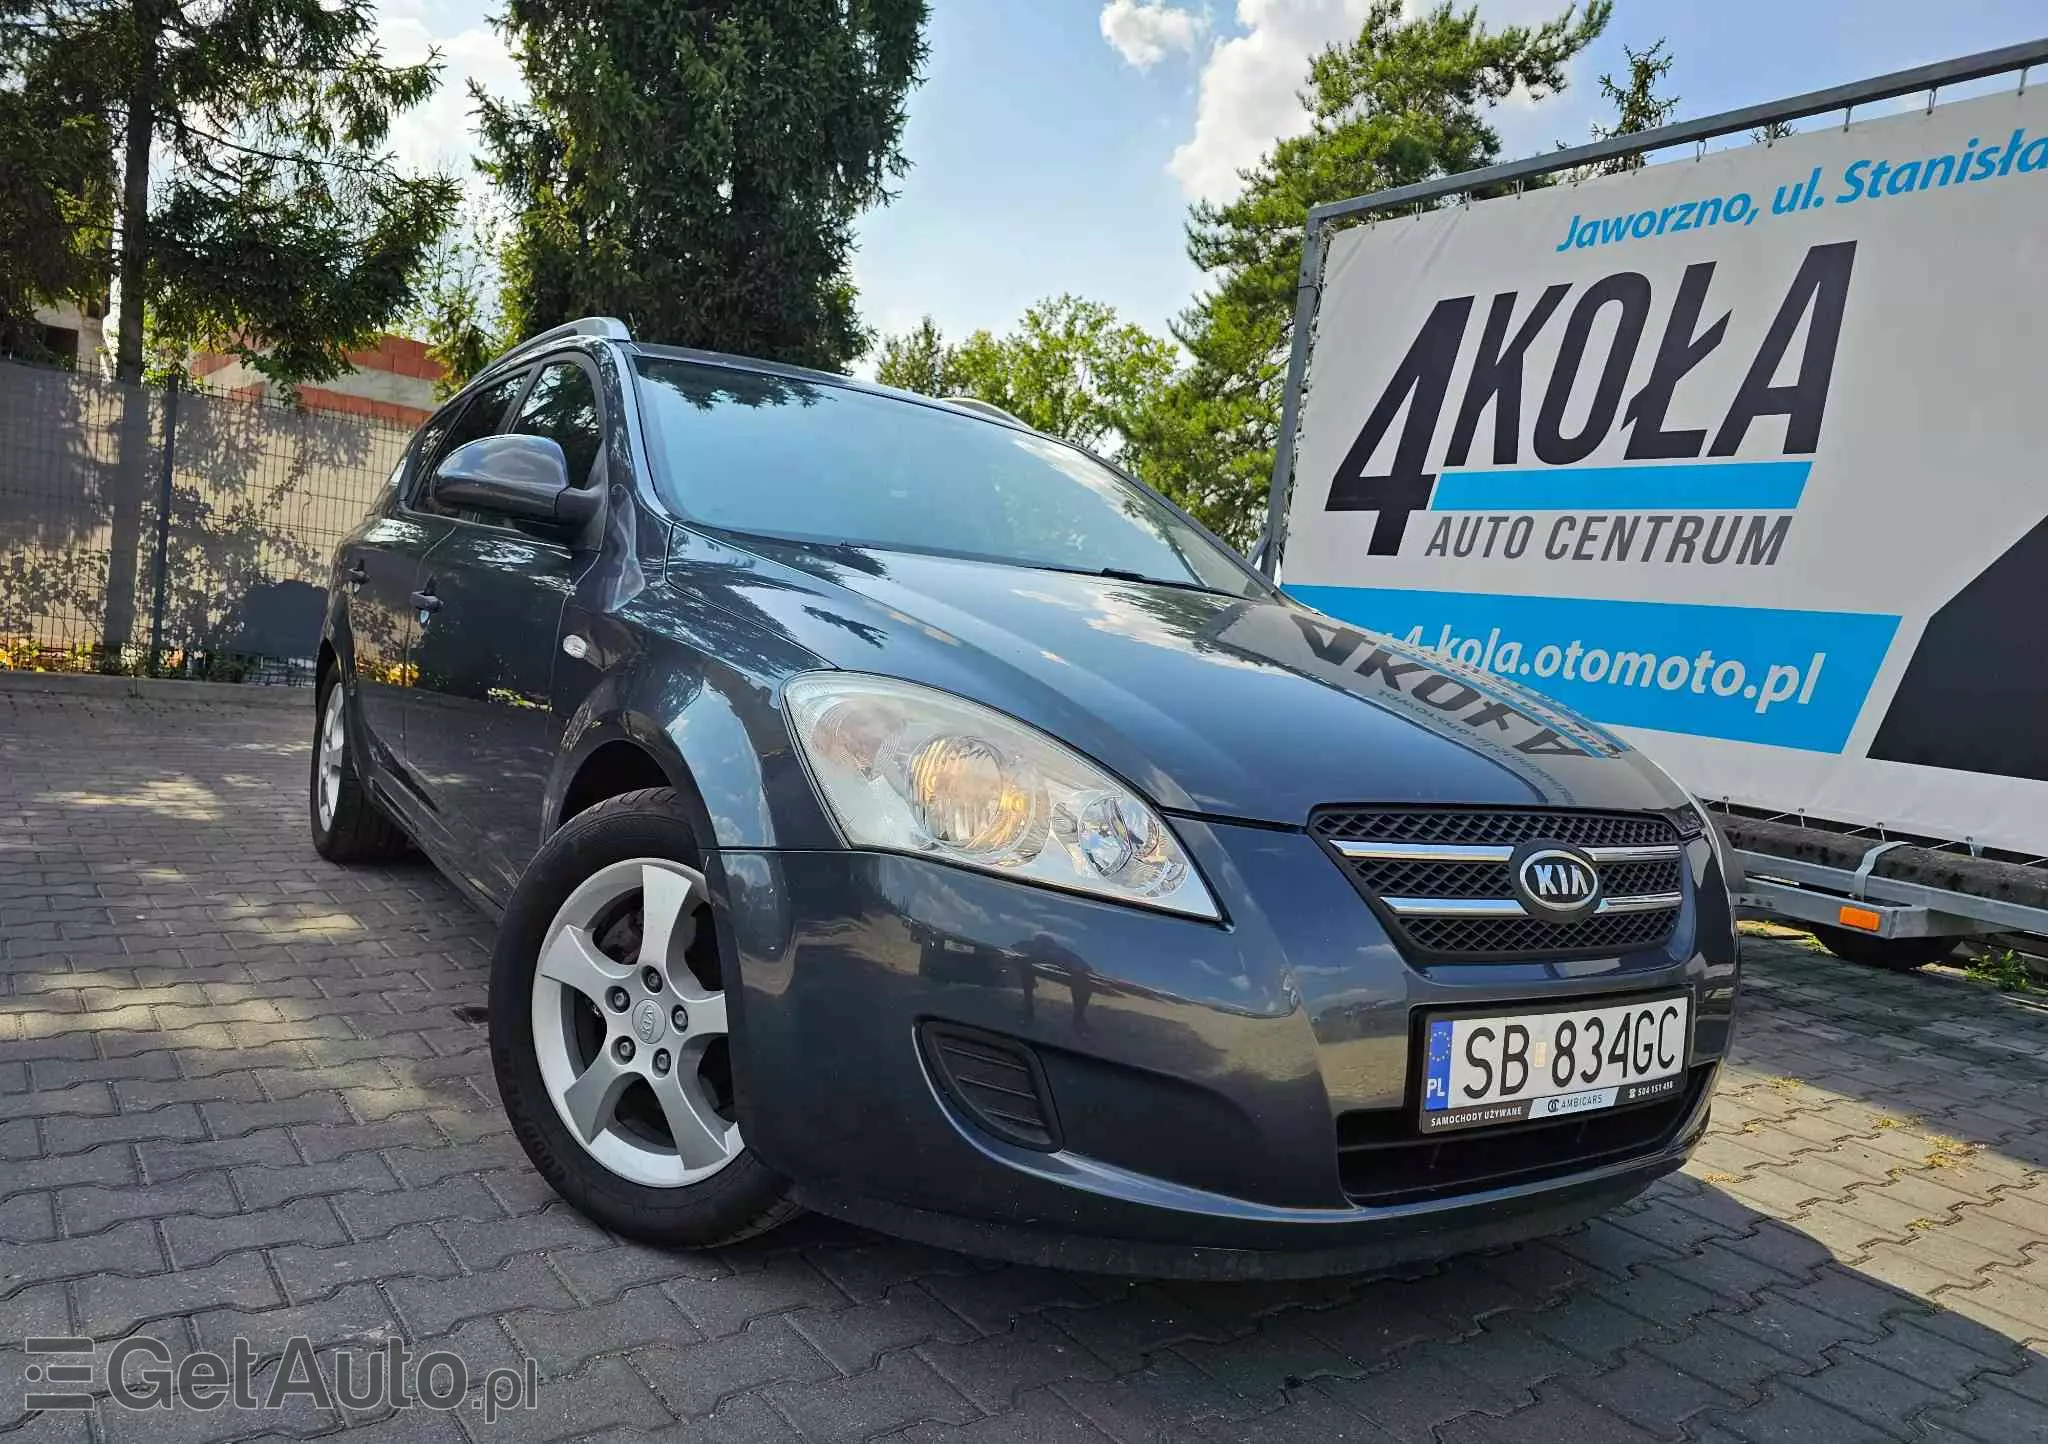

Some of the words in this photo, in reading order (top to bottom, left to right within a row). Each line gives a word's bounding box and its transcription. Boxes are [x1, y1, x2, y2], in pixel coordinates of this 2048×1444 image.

[1556, 192, 1760, 253] Jaworzno,
[1771, 167, 1824, 216] ul.
[1324, 240, 1858, 557] 4KOŁA
[1425, 514, 1531, 559] AUTO
[1544, 514, 1793, 567] CENTRUM
[1394, 621, 1827, 714] 4-kola.otomoto.pl
[1533, 864, 1589, 895] KIA
[1463, 1024, 1530, 1100] SB
[1551, 1006, 1679, 1088] 834GC
[1426, 1077, 1445, 1099] PL
[1431, 1111, 1483, 1128] SAMOCHODY
